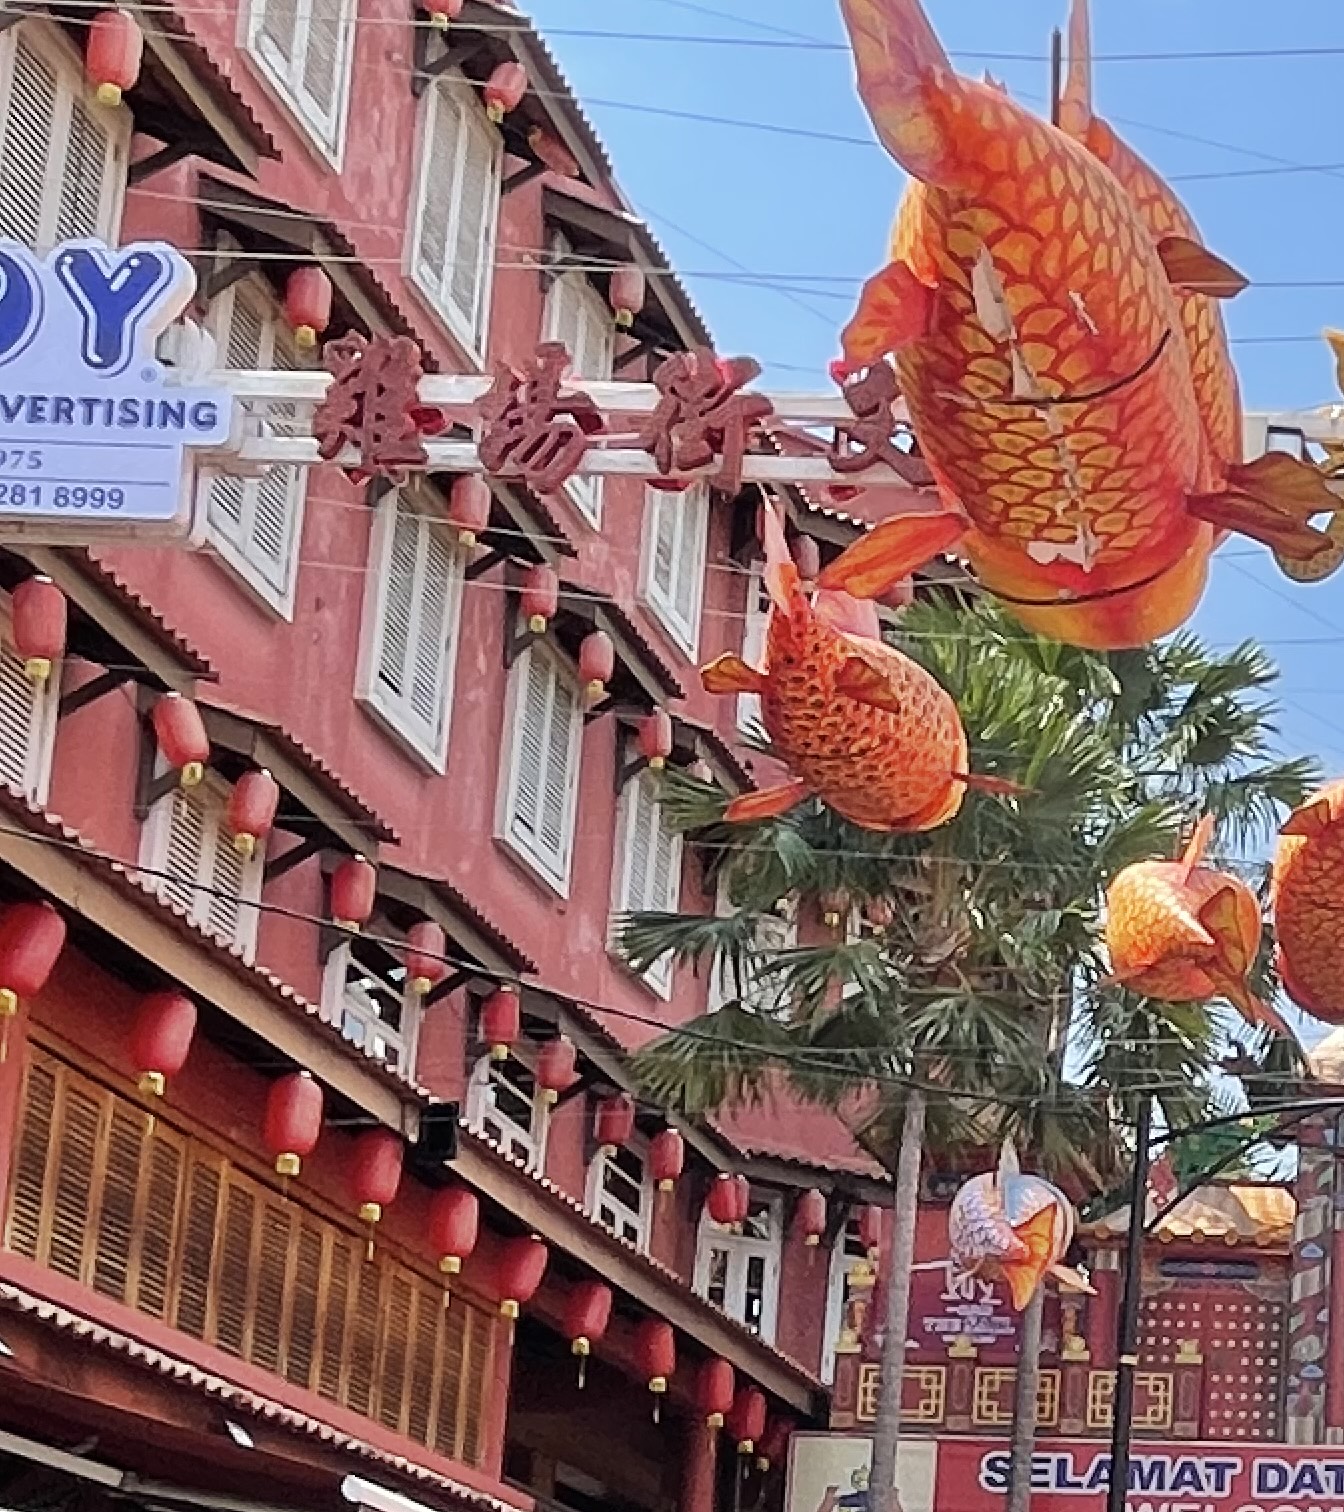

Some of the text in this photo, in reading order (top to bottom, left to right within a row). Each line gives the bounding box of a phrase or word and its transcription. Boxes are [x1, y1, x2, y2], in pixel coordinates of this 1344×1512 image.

[0, 394, 218, 432] VERTISING
[0, 450, 42, 470] 75
[53, 485, 124, 509] 8999
[981, 1453, 1240, 1495] SELAMAT
